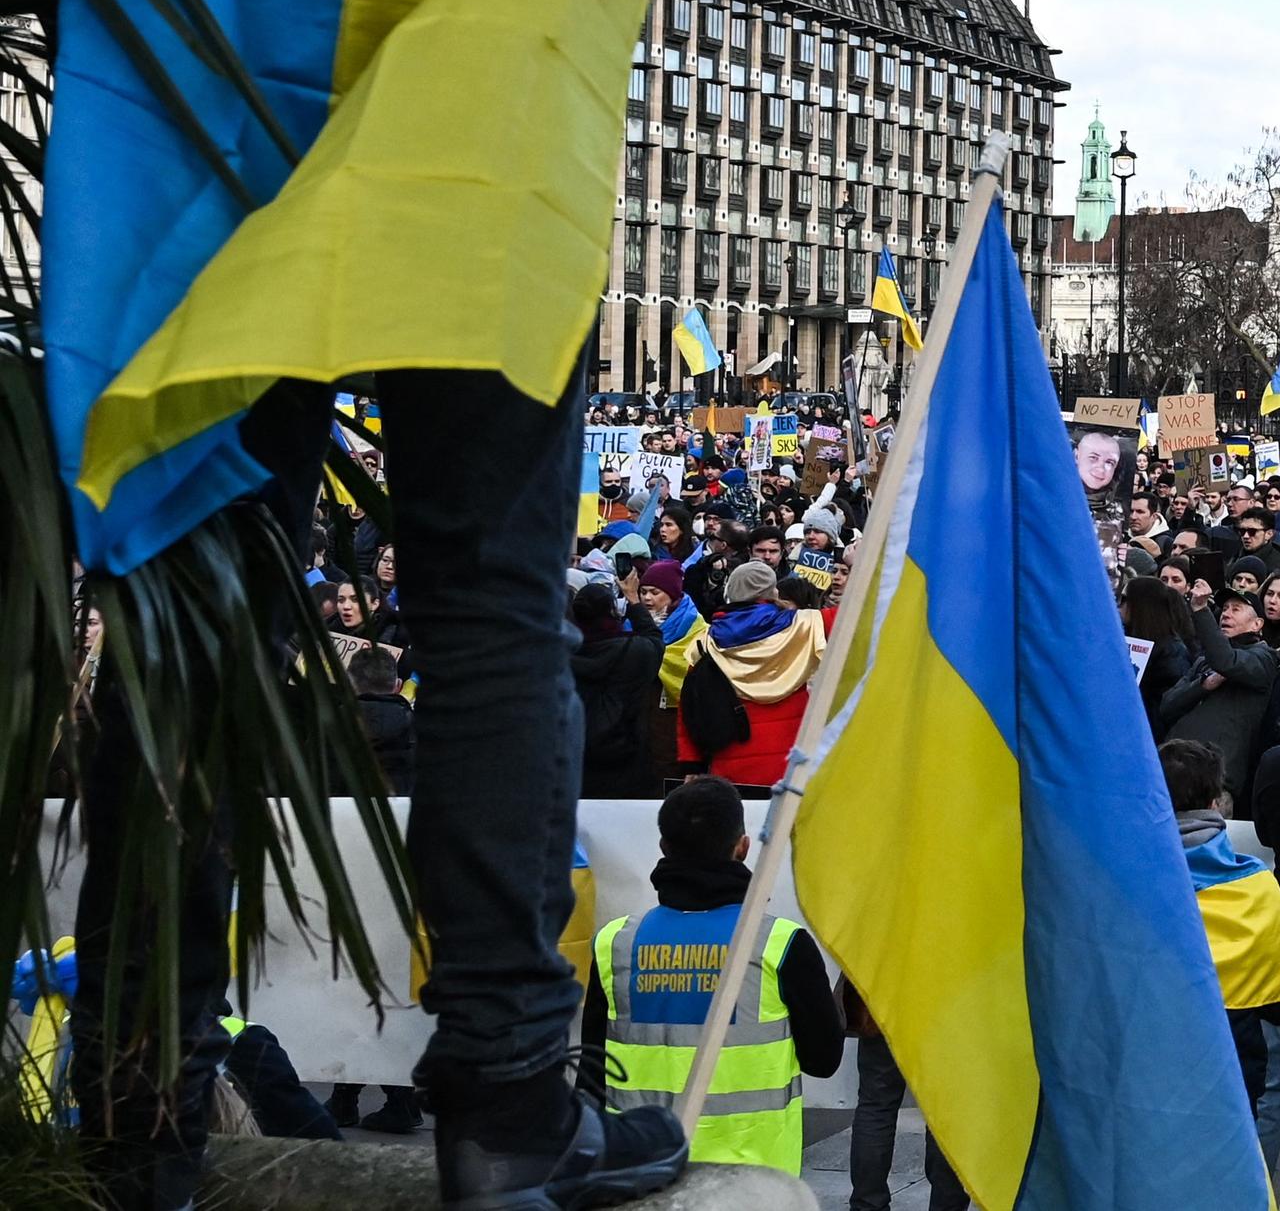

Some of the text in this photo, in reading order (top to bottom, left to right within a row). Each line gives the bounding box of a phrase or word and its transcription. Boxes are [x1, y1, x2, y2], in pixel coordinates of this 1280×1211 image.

[1166, 394, 1206, 409] STOP
[1165, 411, 1202, 428] WAR
[584, 432, 629, 454] THE
[776, 439, 797, 453] SKY
[1173, 434, 1215, 450] UKRAINE
[637, 943, 729, 970] UKRAINIAN
[636, 972, 721, 993] SUPPORT TEA
